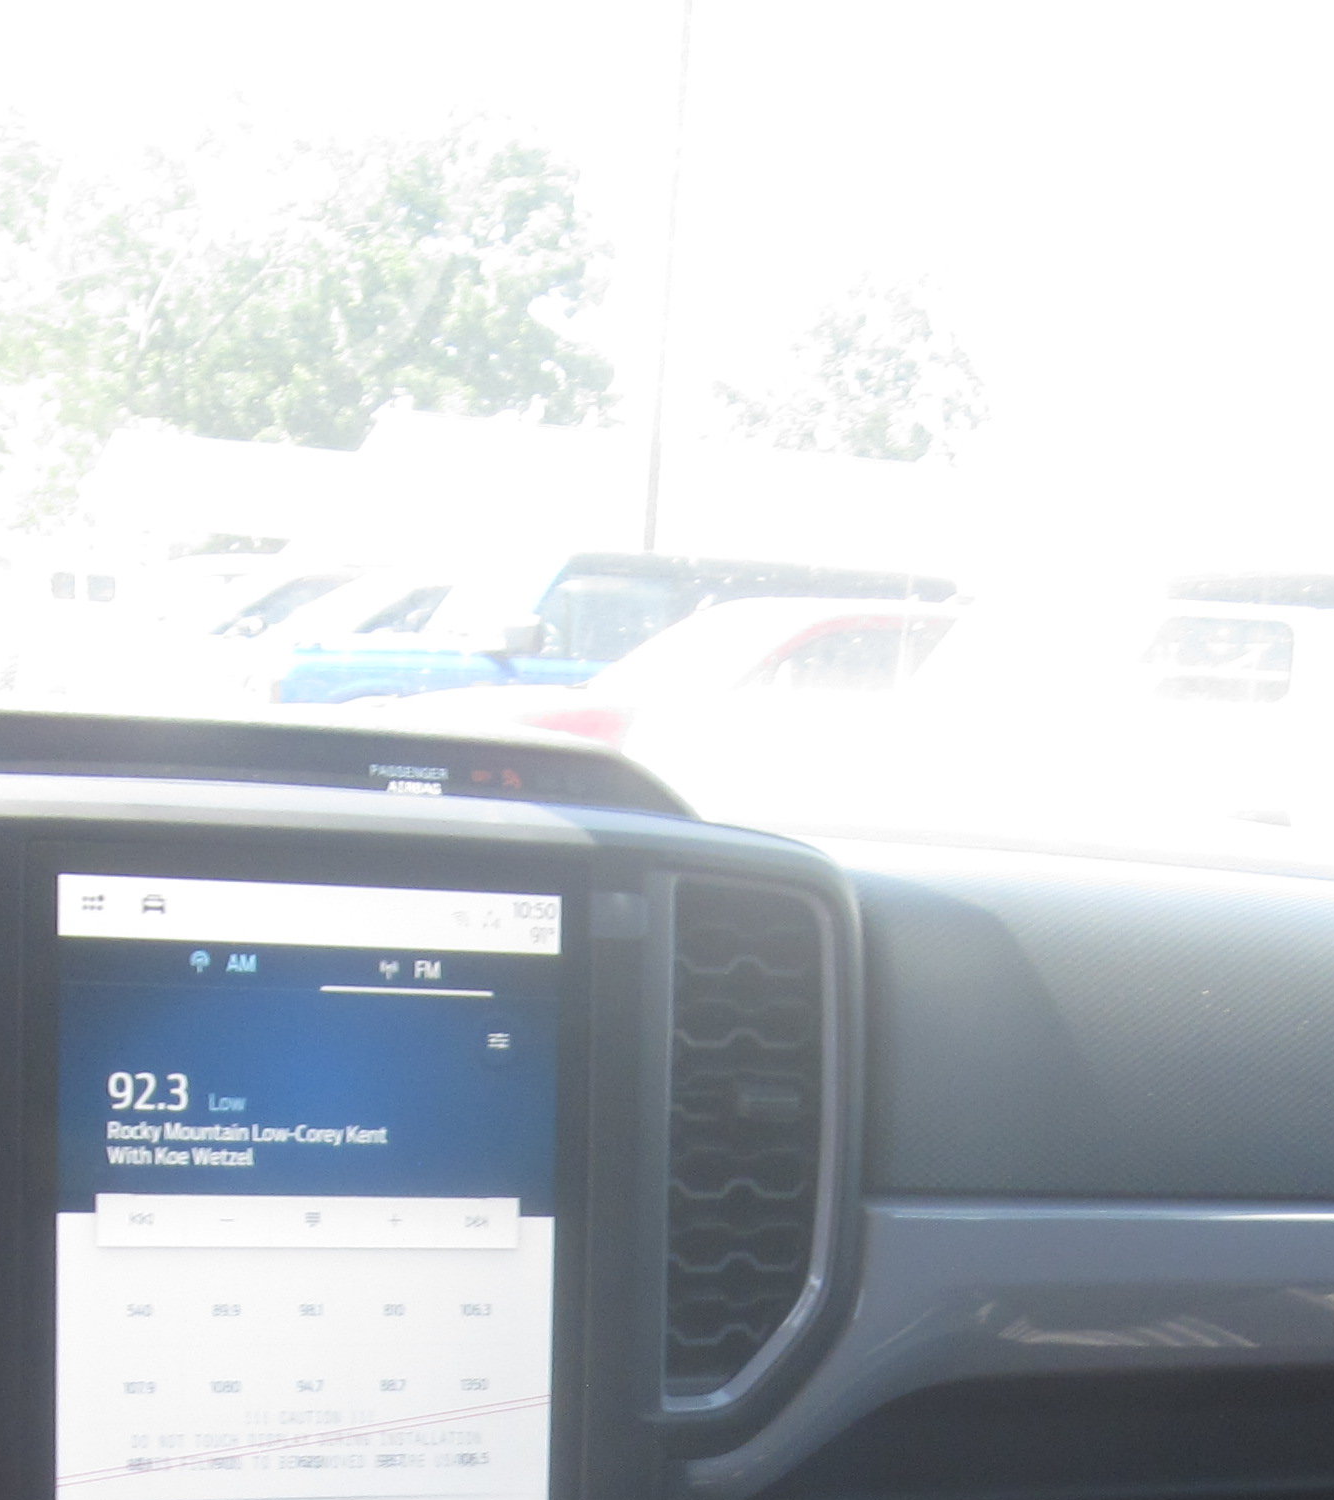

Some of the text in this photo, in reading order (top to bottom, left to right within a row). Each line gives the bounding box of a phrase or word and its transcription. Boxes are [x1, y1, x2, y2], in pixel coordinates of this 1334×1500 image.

[386, 779, 443, 796] AIRBAG
[513, 901, 558, 920] 10:50
[226, 953, 257, 973] AM
[413, 960, 442, 979] FM
[107, 1071, 247, 1113] 92.3 Low
[107, 1121, 388, 1146] Rocky Mountain Low-Corey Kent
[107, 1146, 255, 1167] With Koe Wetzel
[278, 1410, 342, 1425] CAUTION
[195, 1433, 240, 1448] TOUCH
[380, 1430, 482, 1446] INSTALLATION
